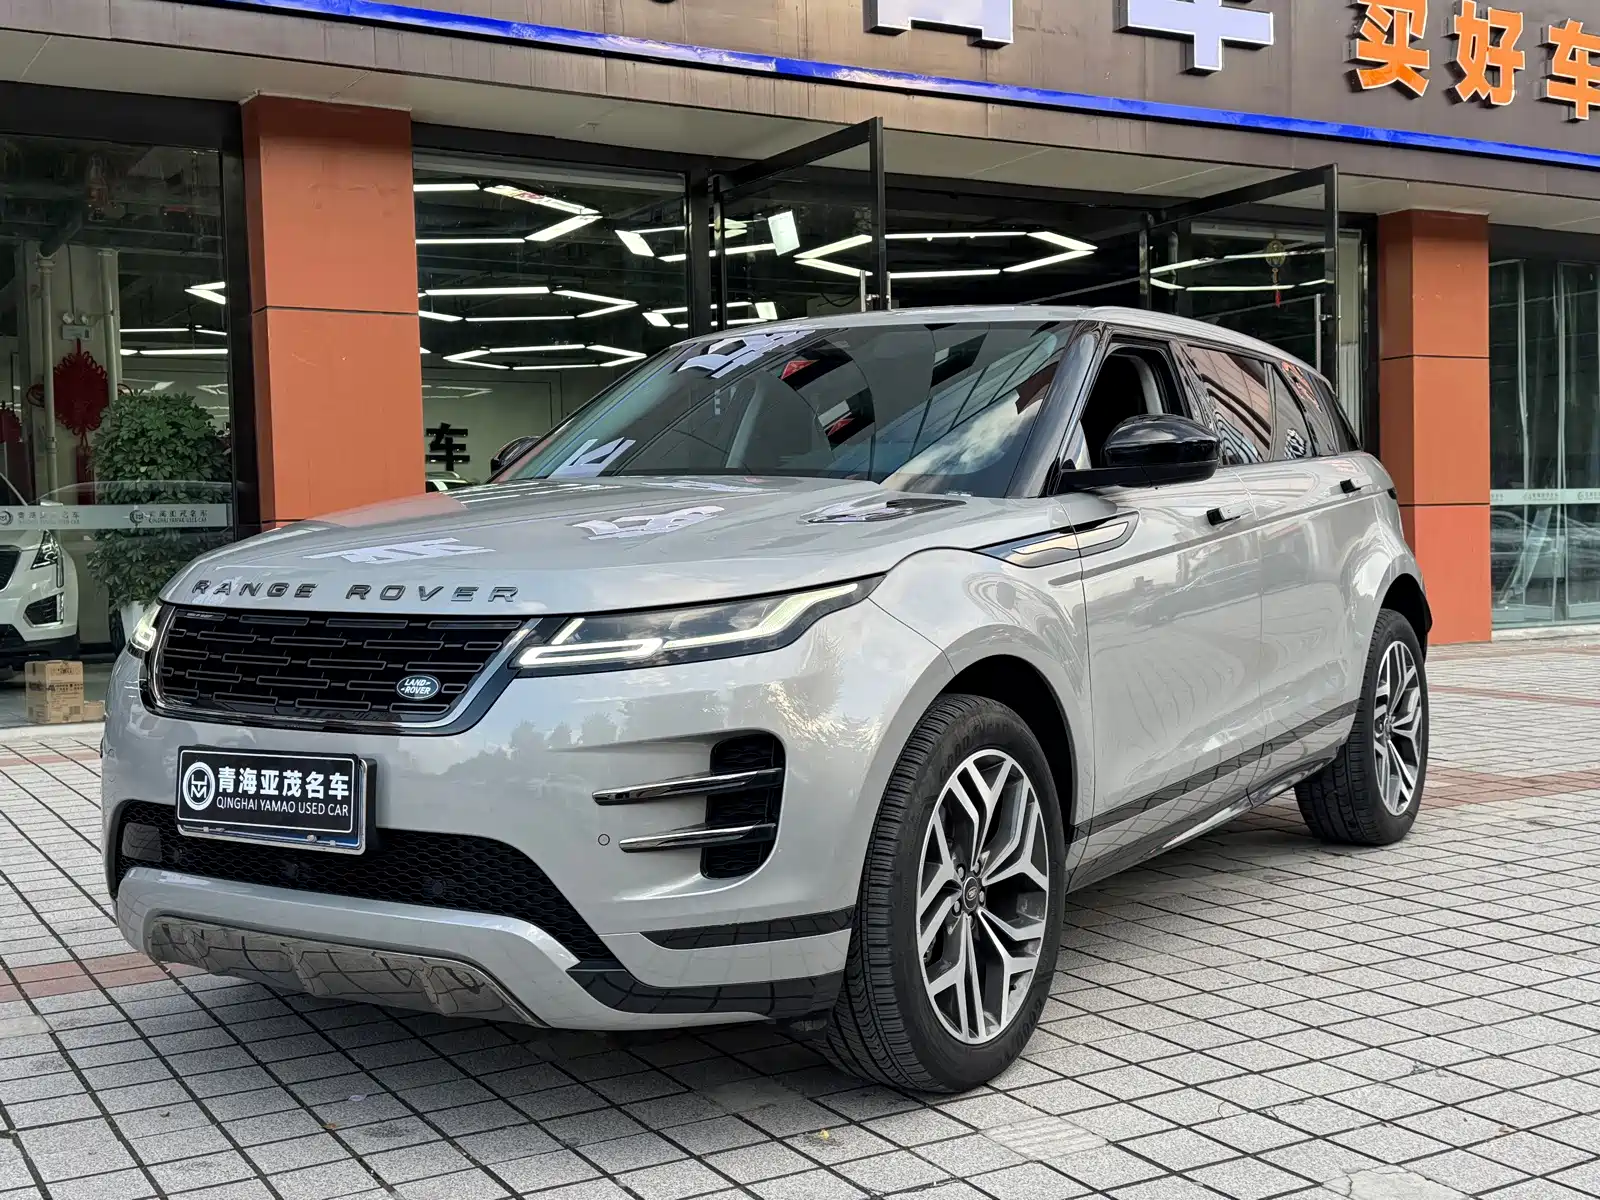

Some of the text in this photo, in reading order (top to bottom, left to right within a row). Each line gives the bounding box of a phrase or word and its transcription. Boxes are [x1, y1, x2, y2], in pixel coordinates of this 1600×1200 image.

[1355, 0, 1600, 120] 买好车
[425, 422, 470, 471] 车
[191, 579, 518, 603] RANGE ROVER
[404, 686, 431, 694] ROVER
[218, 766, 349, 800] 青海亚茂名车
[216, 796, 349, 817] QINGHAI YAMAO USED CAR
